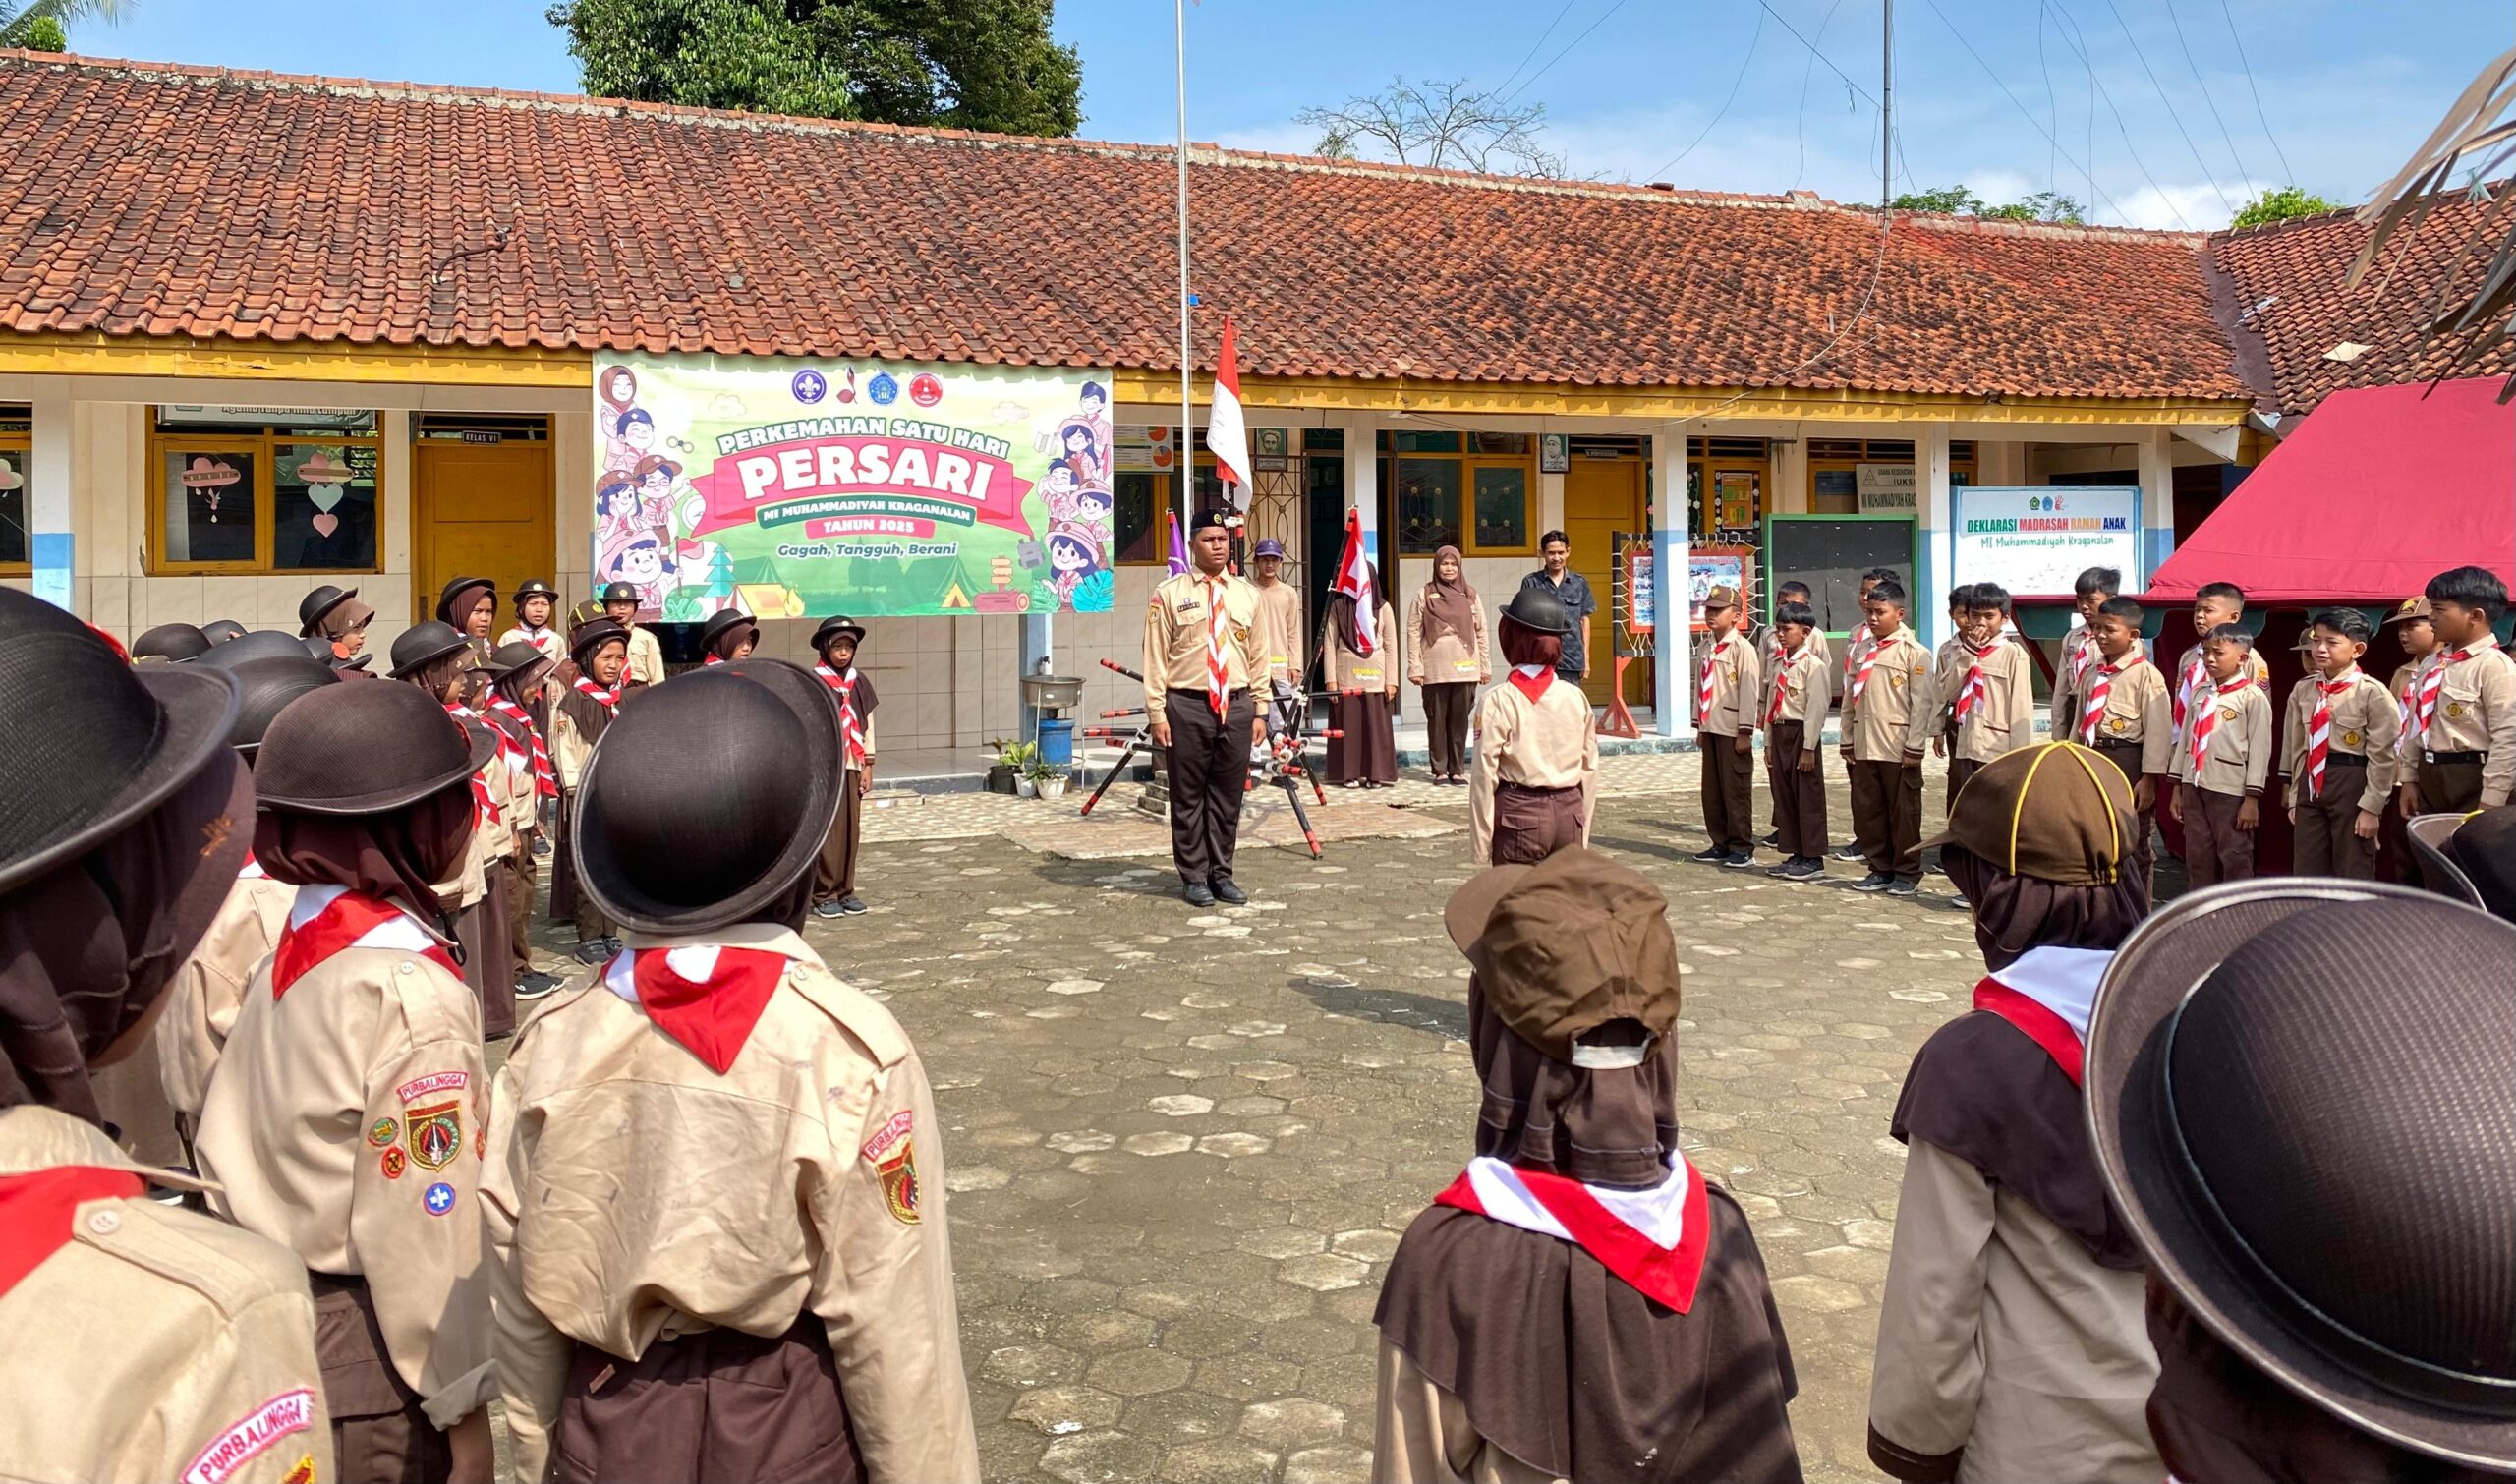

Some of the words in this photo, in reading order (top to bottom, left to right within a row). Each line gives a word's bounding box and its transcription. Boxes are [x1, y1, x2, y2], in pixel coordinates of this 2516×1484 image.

[465, 433, 486, 442] KELAS
[716, 417, 886, 455] PERKEMAHAN
[890, 418, 950, 443] SATU
[952, 428, 1010, 460] HARI
[736, 444, 995, 501] PERSARI
[763, 510, 779, 521] MI
[782, 500, 886, 518] MUHAMMADIYAH
[887, 501, 971, 521] KRAGANALAN
[823, 519, 875, 533] TAHUN
[878, 519, 915, 533] 2025
[1967, 519, 2018, 533] DEKLARASI
[2019, 518, 2069, 531] MADRASAH
[2070, 518, 2102, 531] RAMAH
[2103, 517, 2127, 530] ANAK
[777, 543, 831, 558] Gagah,
[835, 543, 904, 559] Tangguh,
[908, 543, 958, 555] Berani
[1980, 537, 1993, 548] MI
[1995, 535, 2065, 549] Muhammadiyah
[2068, 535, 2114, 548] Kraganalan
[402, 1074, 462, 1098] PURBALINGGA
[199, 1398, 302, 1483] PURBALINGGA
